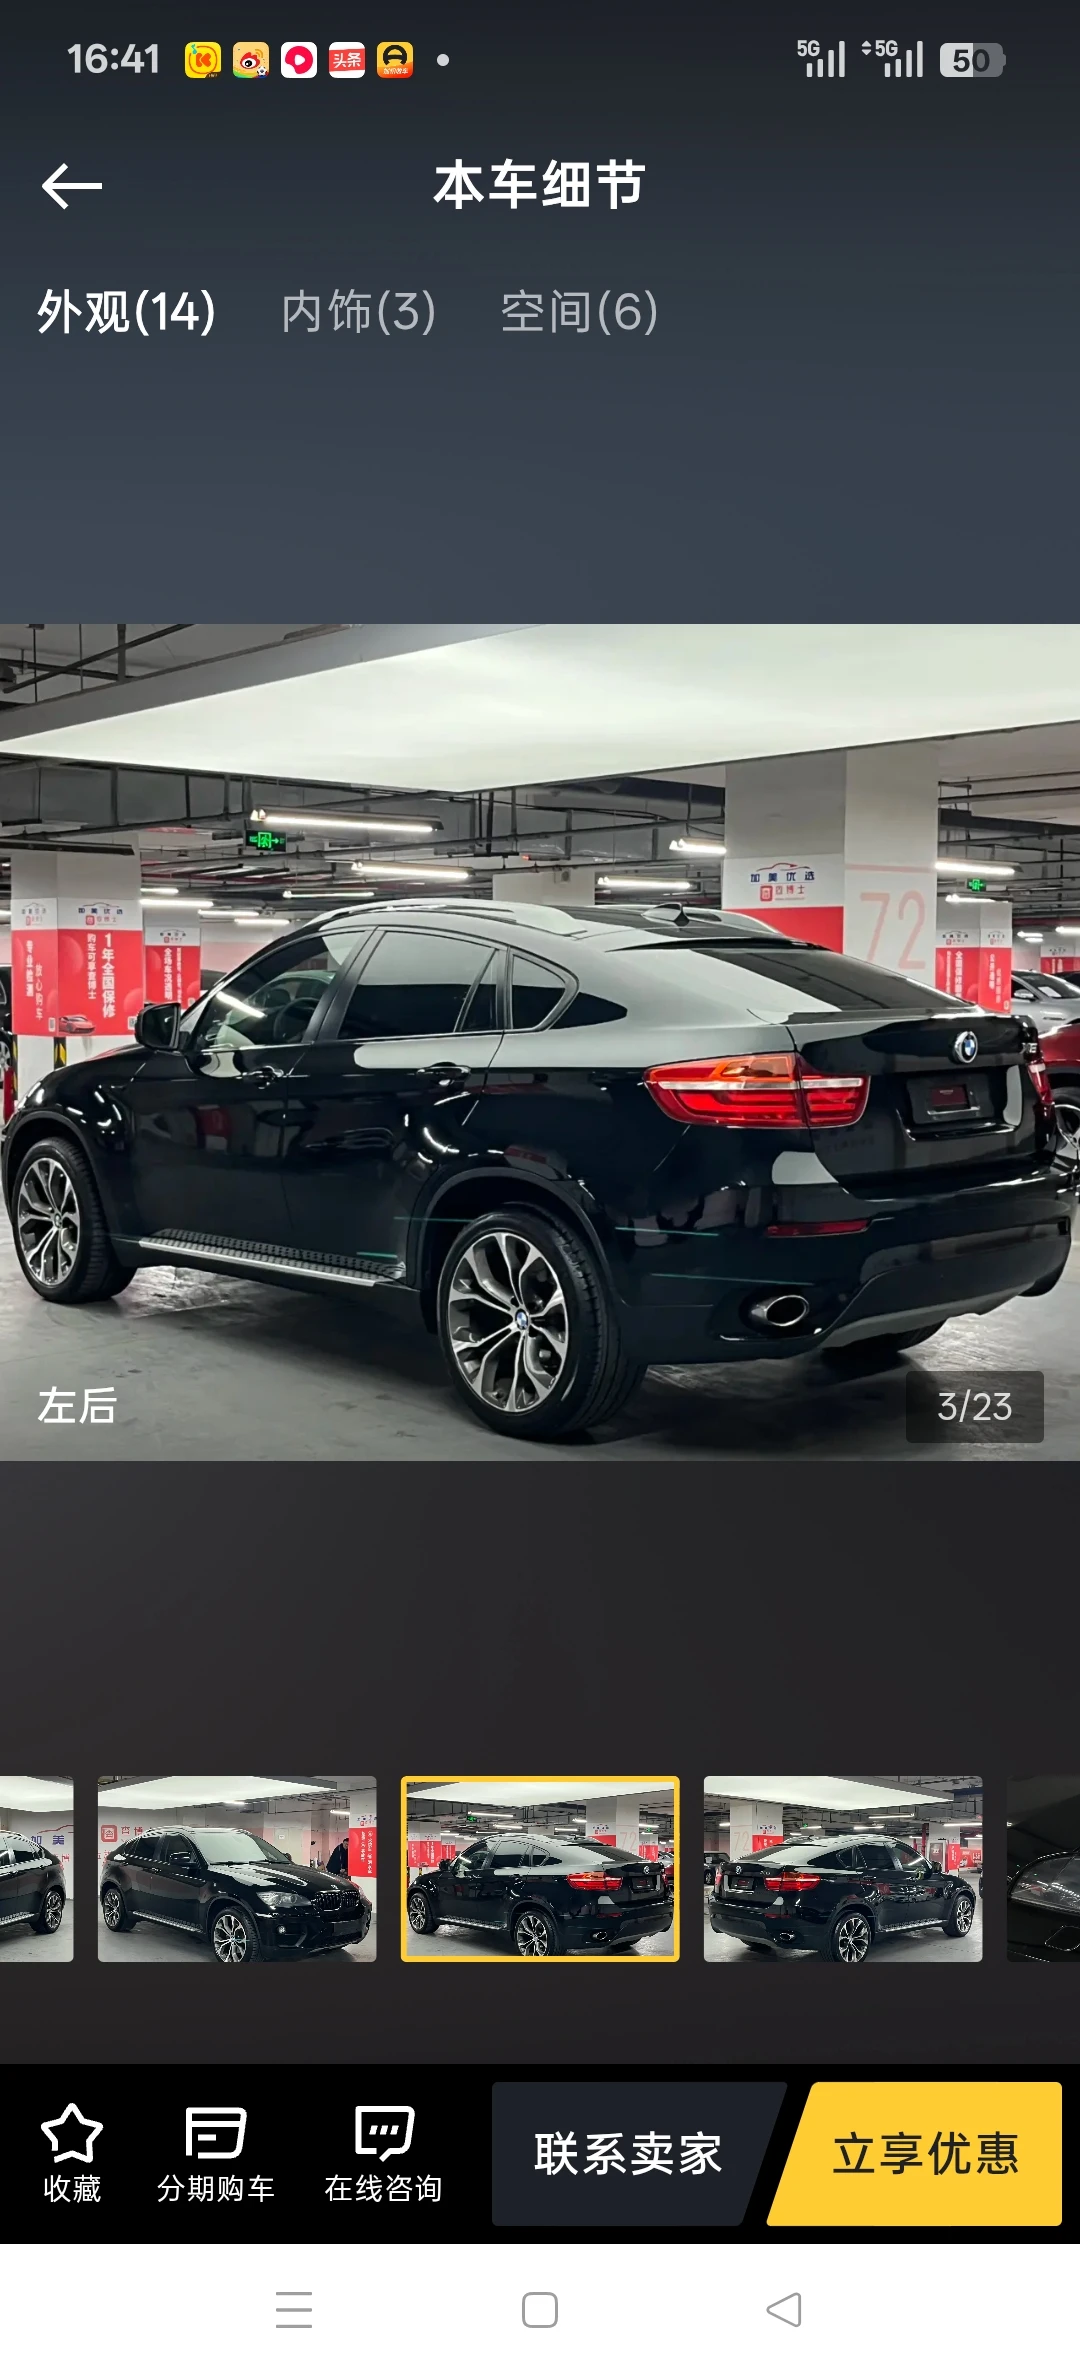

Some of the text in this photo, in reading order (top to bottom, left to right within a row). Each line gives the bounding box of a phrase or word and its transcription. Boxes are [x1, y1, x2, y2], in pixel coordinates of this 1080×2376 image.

[68, 44, 158, 74] 16:41
[333, 52, 362, 69] 头条
[797, 40, 820, 57] 5G
[875, 40, 898, 57] 5G
[953, 48, 990, 73] 50
[433, 159, 646, 209] 本车细节
[37, 289, 215, 336] 外观(14)
[282, 289, 435, 336] 内饰(3)
[501, 289, 657, 336] 空间(6)
[859, 889, 926, 970] 72
[101, 932, 116, 1019] 1年全国保修
[534, 2131, 723, 2175] 联系卖家
[833, 2130, 1018, 2176] 立享优惠
[43, 2174, 102, 2203] 收藏
[157, 2174, 275, 2203] 分期购车
[324, 2174, 442, 2203] 在线咨询
